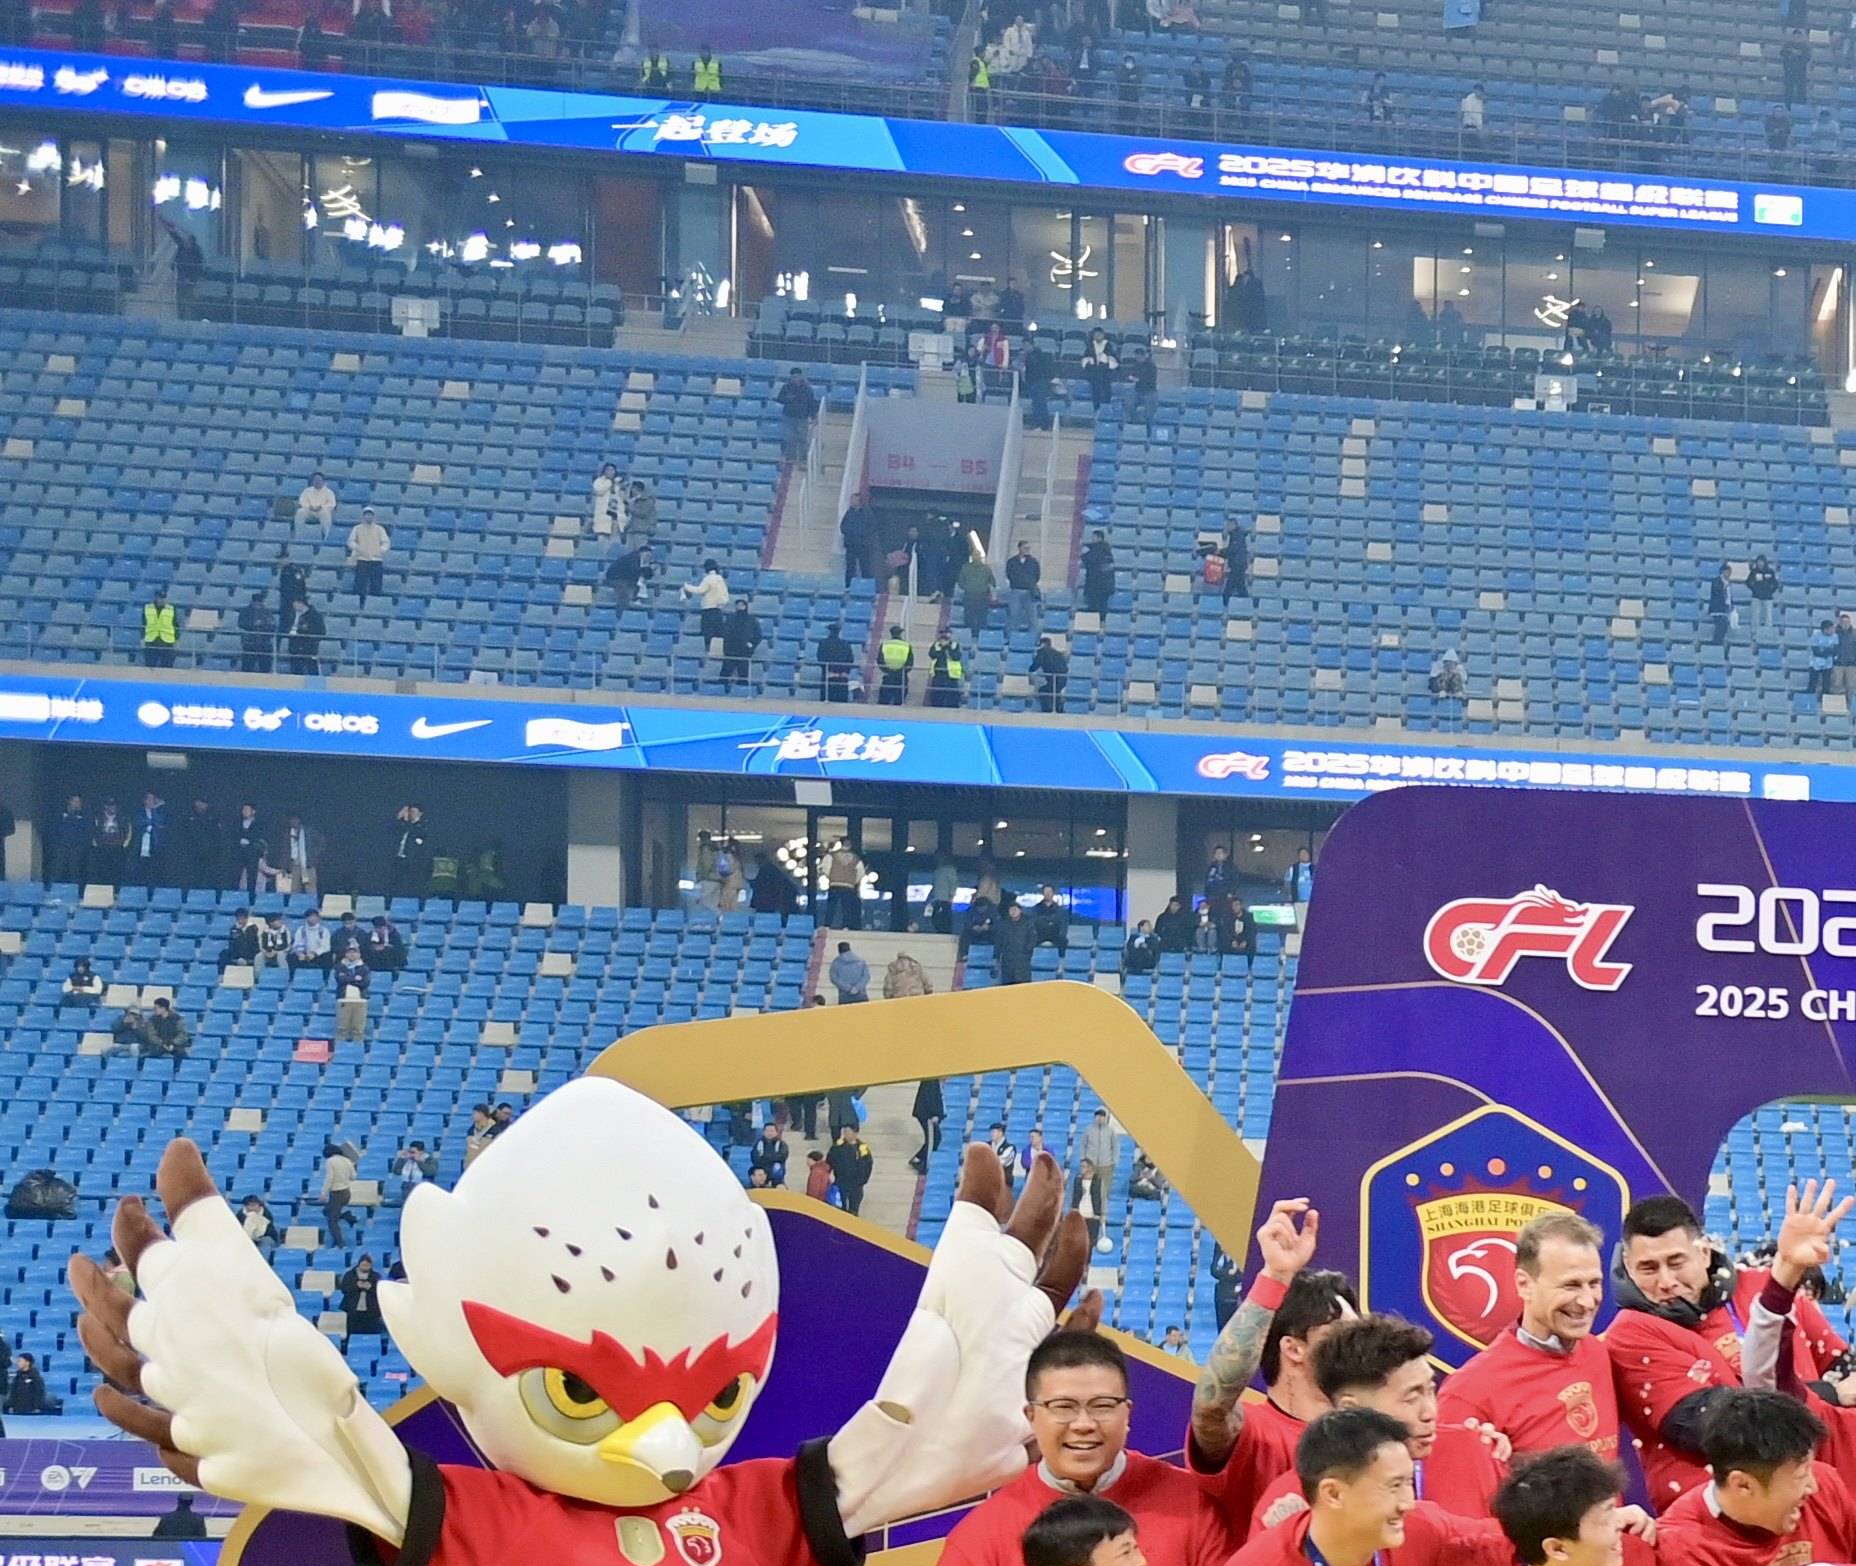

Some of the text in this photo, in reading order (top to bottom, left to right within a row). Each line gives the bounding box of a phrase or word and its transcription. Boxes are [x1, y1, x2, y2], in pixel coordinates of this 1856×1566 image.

[888, 453, 987, 475] B4 B5
[737, 729, 905, 763] 一起登场
[1694, 984, 1790, 1018] 2025
[1423, 1199, 1549, 1223] 上海海港足球俱
[1426, 1217, 1531, 1234] SHANGHAI PO
[140, 1472, 186, 1486] Leno
